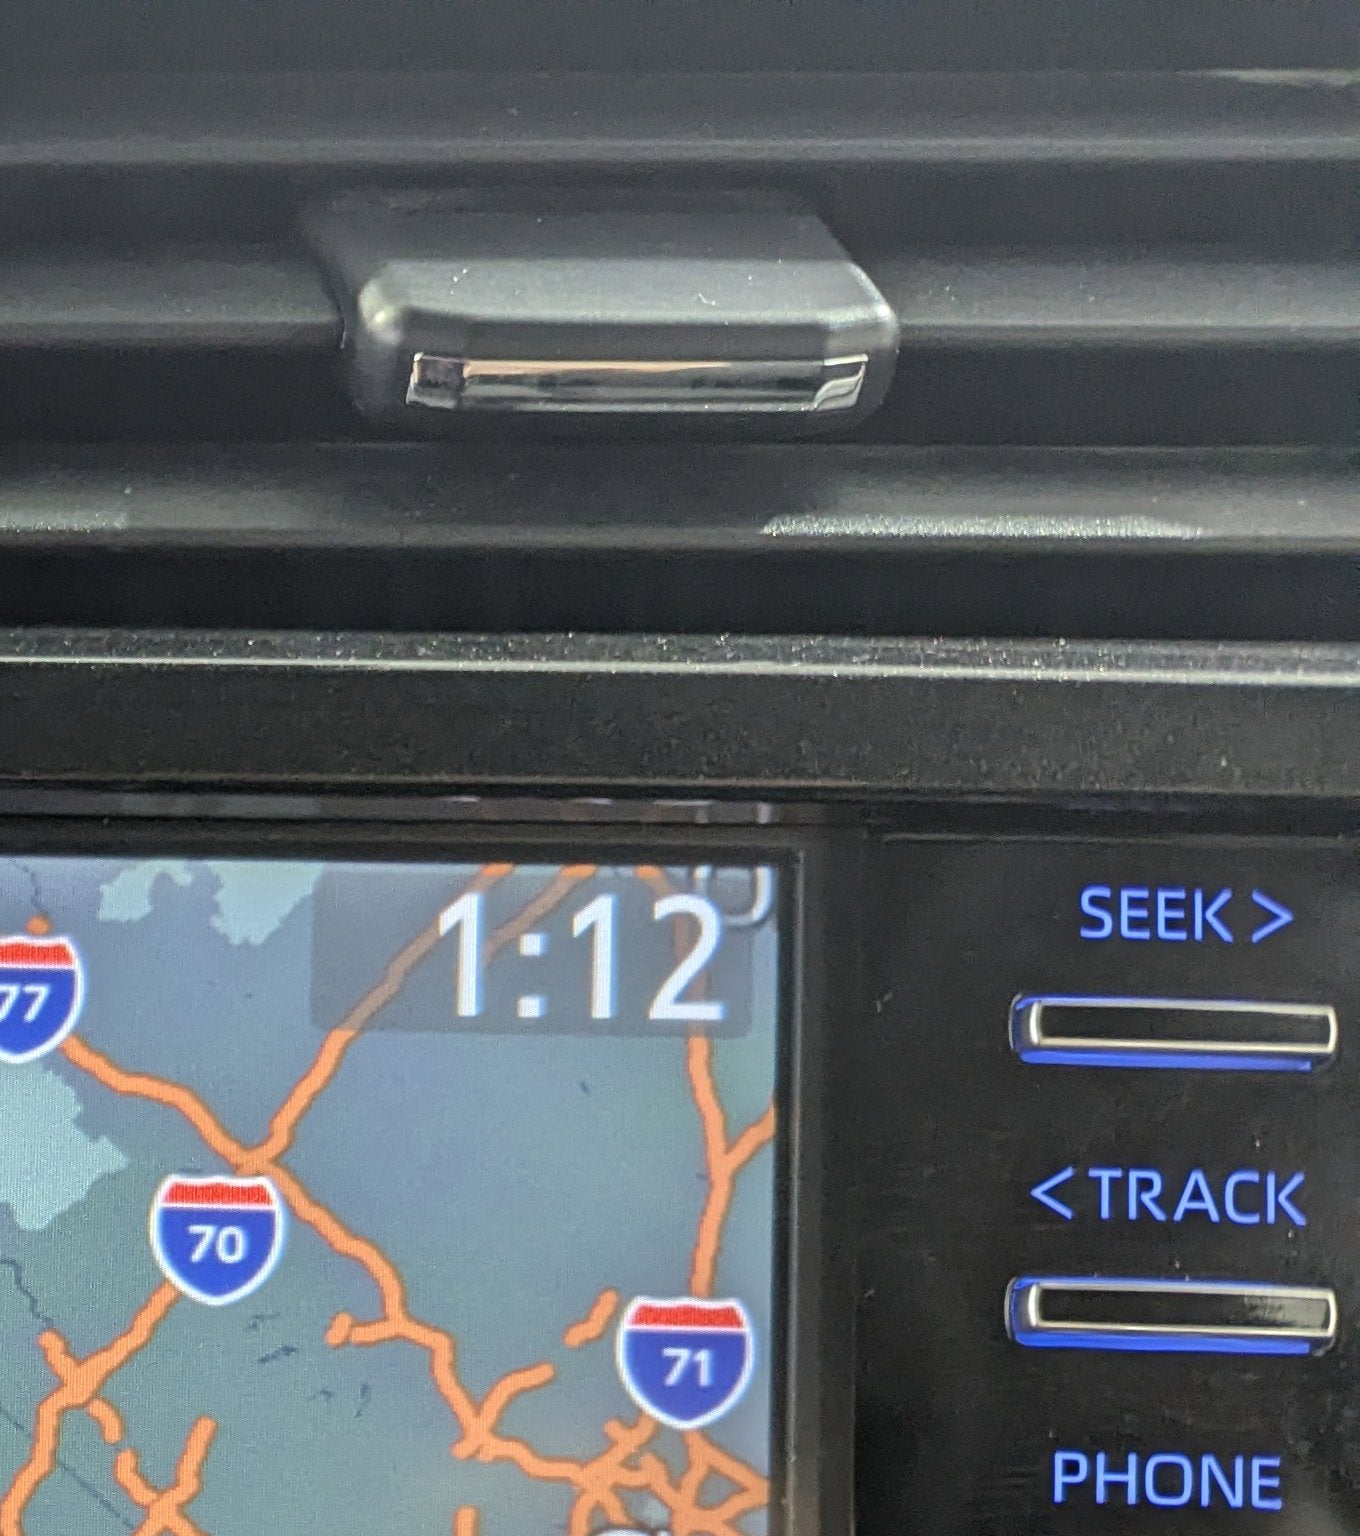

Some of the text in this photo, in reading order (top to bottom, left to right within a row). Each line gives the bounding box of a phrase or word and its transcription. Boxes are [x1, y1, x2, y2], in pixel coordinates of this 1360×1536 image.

[1080, 885, 1233, 943] SEEK
[438, 891, 727, 1023] 1:12
[1088, 1167, 1307, 1227] TRACK
[186, 1222, 247, 1268] 70
[661, 1345, 715, 1389] 71
[1053, 1449, 1283, 1511] PHONE
